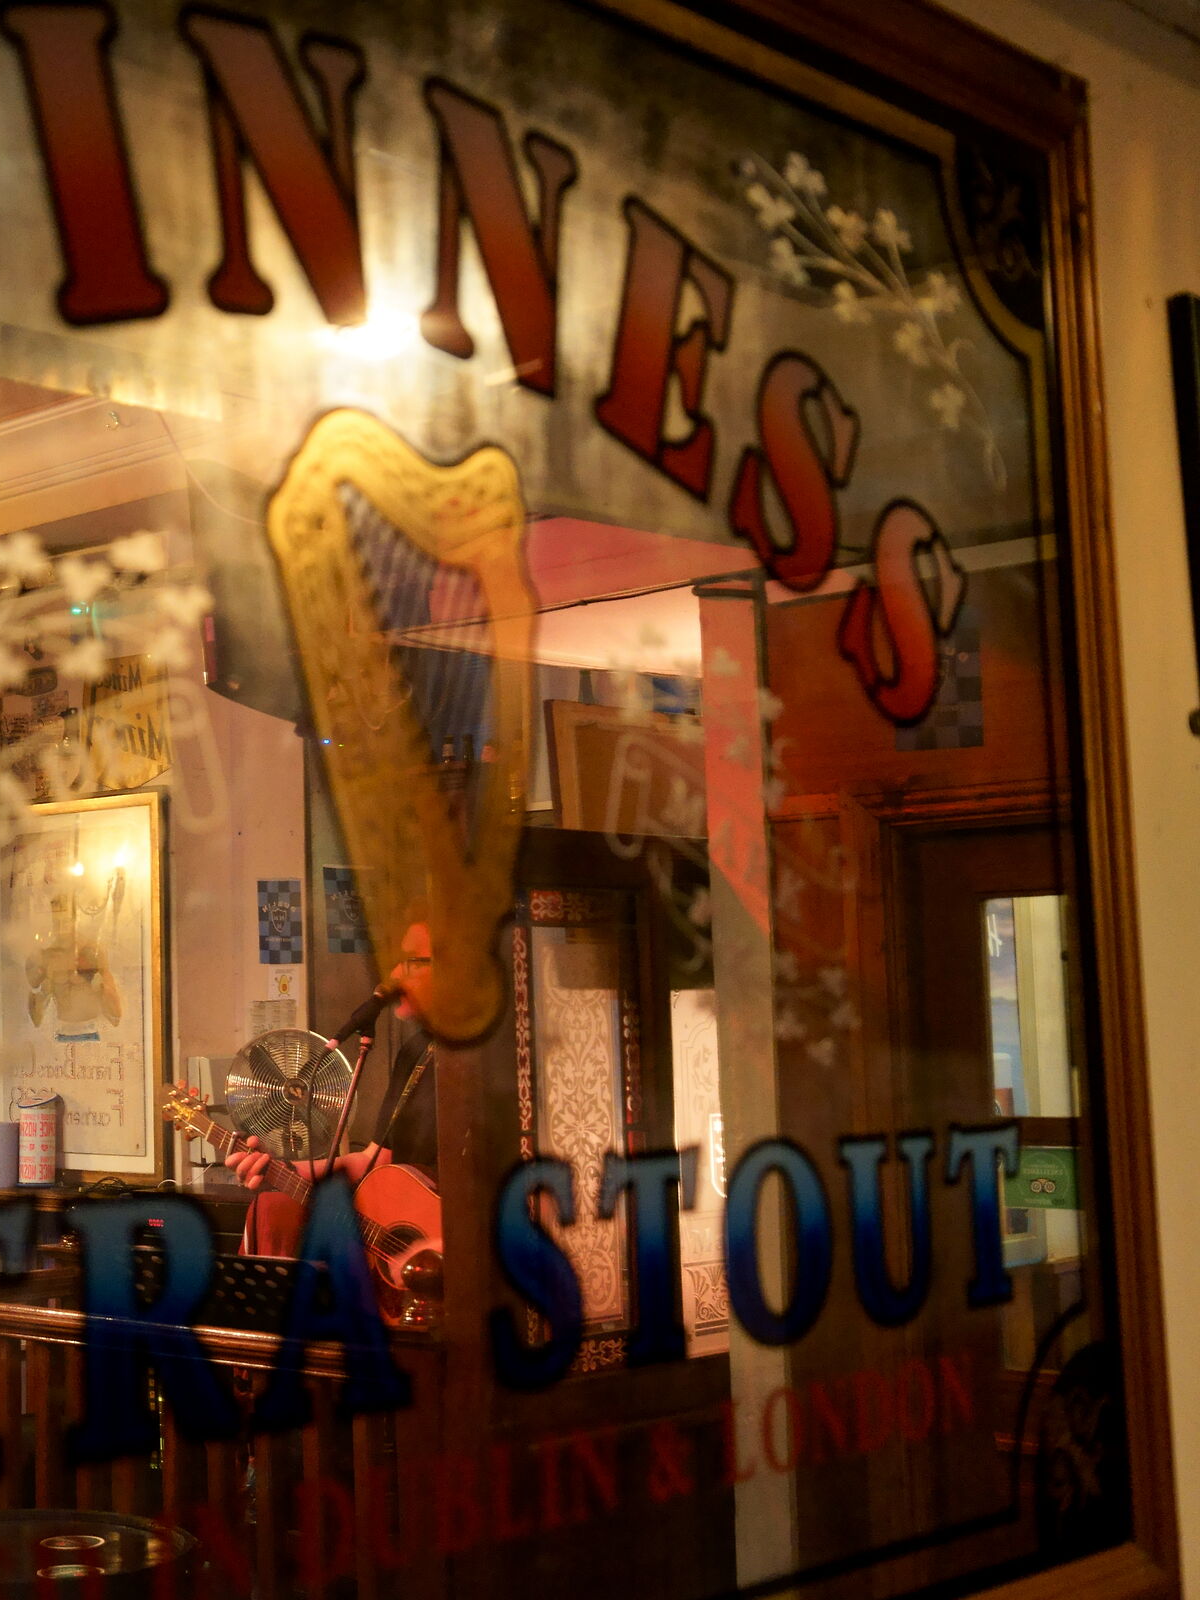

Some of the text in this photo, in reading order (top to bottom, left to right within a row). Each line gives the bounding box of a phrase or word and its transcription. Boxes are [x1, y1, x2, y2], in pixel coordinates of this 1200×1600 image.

[488, 1121, 1019, 1391] STOUT
[296, 1429, 617, 1589] DUBLIN
[647, 1418, 694, 1501] &
[724, 1350, 977, 1486] LONDON
